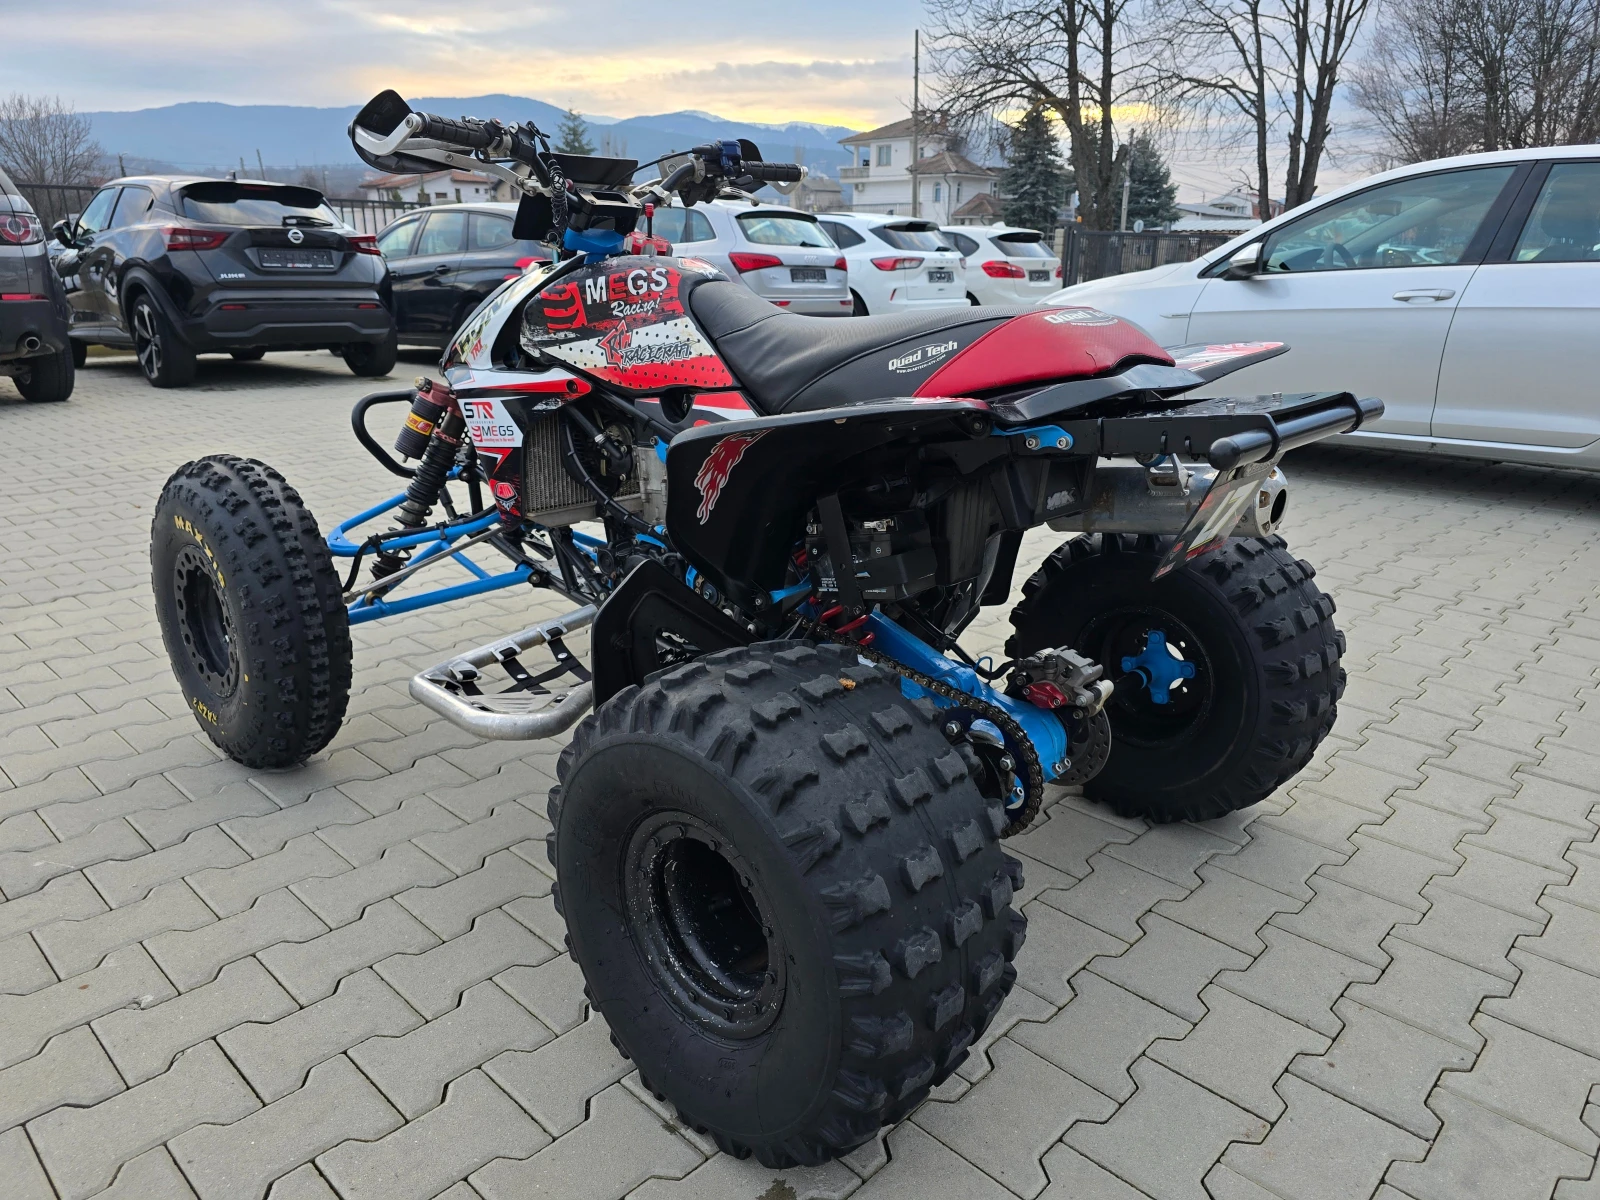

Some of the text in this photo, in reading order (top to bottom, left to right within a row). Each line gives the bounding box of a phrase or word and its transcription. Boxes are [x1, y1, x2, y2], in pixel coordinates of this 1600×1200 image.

[585, 267, 668, 304] MEGS
[611, 292, 663, 317] Racing!
[888, 341, 958, 371] Quad Tech
[464, 401, 495, 420] STR
[482, 425, 514, 437] MEGS
[174, 515, 225, 588] MAXXIS
